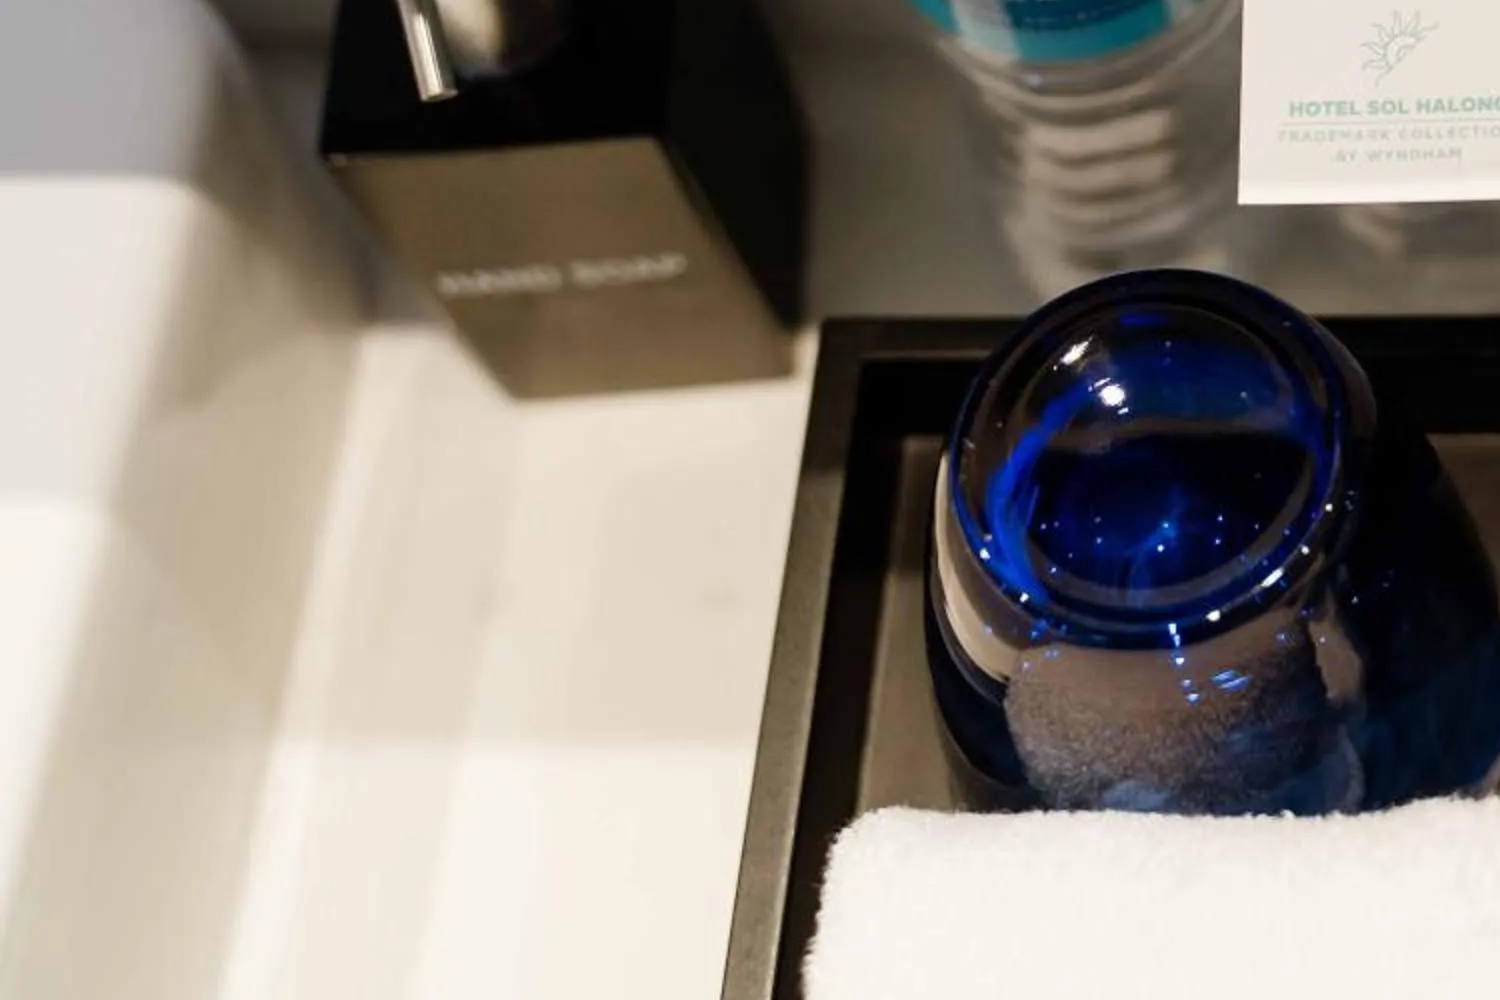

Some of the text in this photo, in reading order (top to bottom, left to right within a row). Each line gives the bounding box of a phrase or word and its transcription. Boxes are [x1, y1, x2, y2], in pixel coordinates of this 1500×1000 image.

[1288, 99, 1361, 118] HOTEL
[1367, 98, 1410, 116] SOL
[1277, 127, 1392, 144] TRADEMARK
[1367, 146, 1464, 163] WYNDHAM
